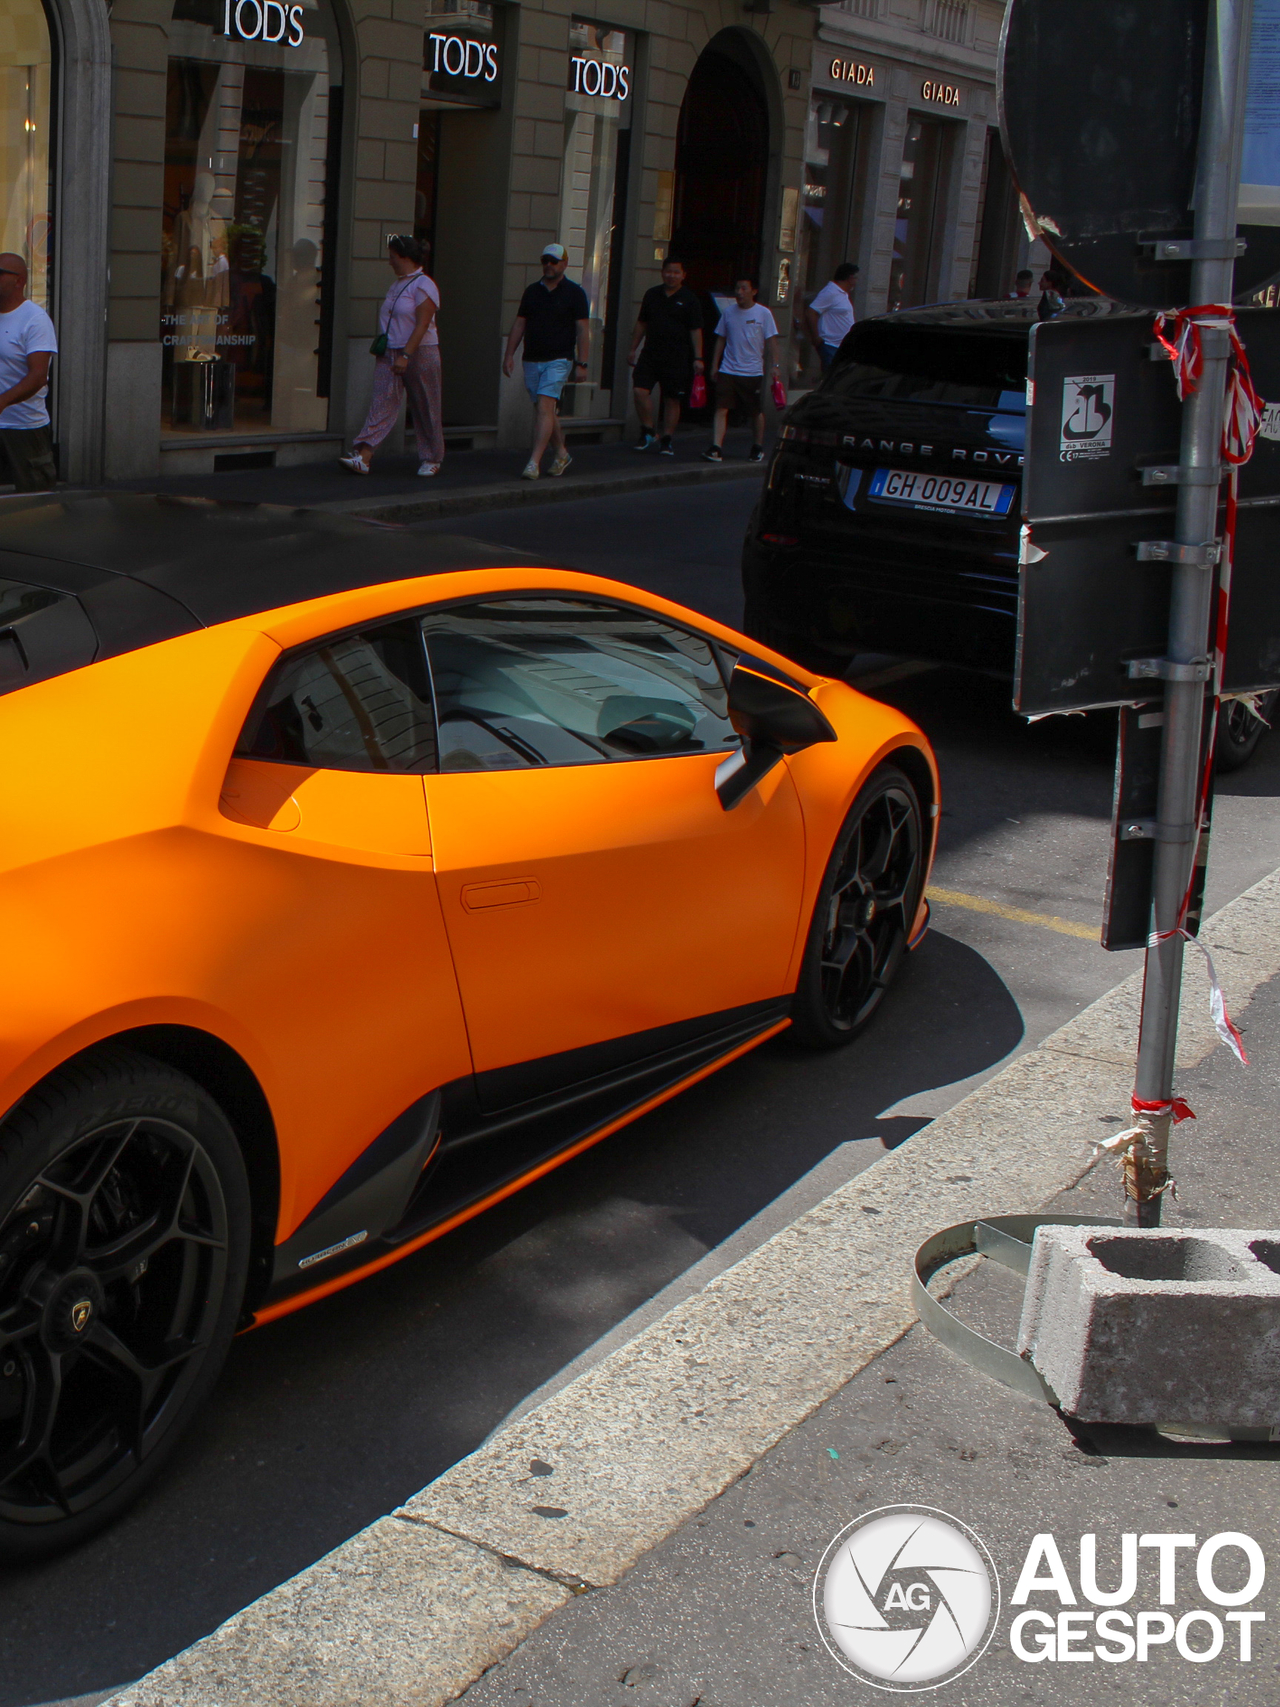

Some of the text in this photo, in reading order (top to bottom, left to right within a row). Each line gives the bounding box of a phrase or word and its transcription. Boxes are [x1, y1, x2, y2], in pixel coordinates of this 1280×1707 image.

[223, 0, 305, 48] TOD'S
[429, 33, 497, 82] TOD'S
[571, 57, 630, 101] TOD'S
[830, 59, 875, 87] GIADA
[922, 80, 960, 107] GIADA
[164, 314, 186, 326] THE
[215, 314, 229, 326] OF
[842, 434, 1026, 466] RANGE ROVE
[1080, 440, 1106, 449] VERONA
[886, 473, 919, 499] GH
[921, 477, 993, 509] 009AL
[914, 503, 956, 515] BRESCIA MOTORI
